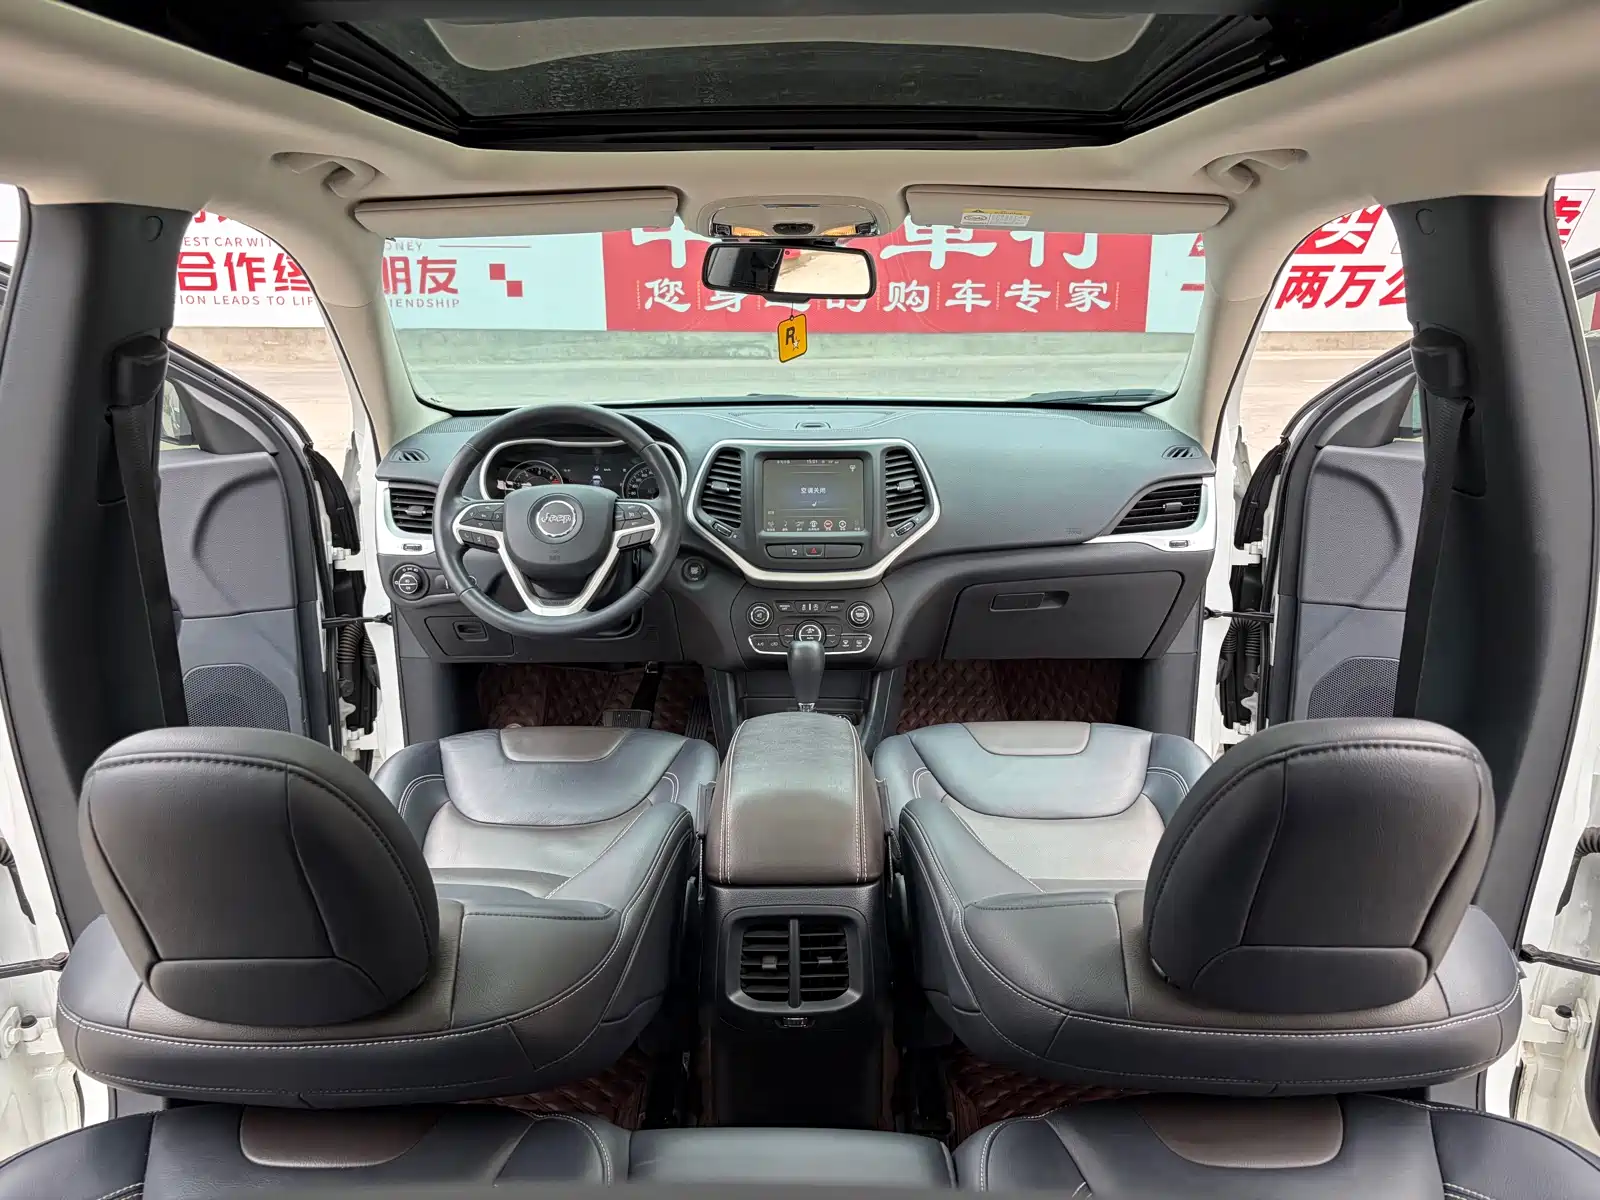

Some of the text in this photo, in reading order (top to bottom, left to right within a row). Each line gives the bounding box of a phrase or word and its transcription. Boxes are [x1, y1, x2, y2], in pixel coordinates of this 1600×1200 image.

[183, 236, 422, 251] EST CAR WIT ONEY
[179, 295, 460, 309] ION LEADS TO LIF IENDSHIP
[540, 512, 572, 525] Jeep
